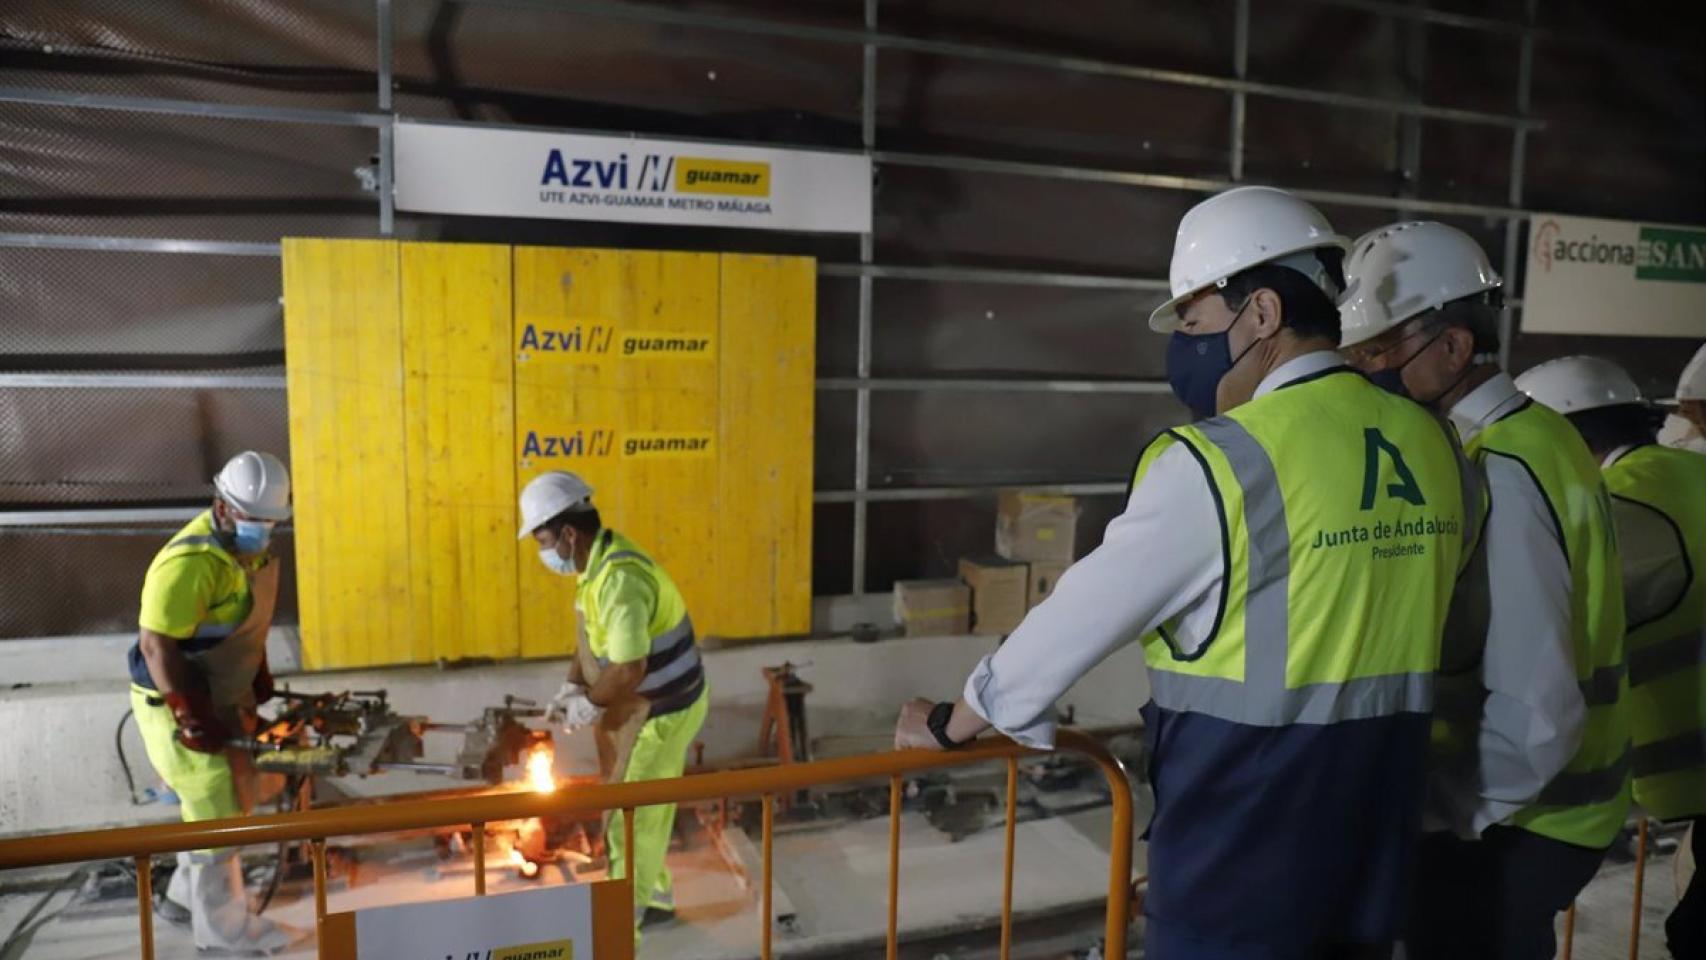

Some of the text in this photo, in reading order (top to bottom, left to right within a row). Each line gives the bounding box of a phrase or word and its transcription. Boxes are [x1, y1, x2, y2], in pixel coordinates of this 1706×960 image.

[541, 148, 761, 190] Azvi guamar
[540, 191, 772, 213] UTE AZVI-GUAMAR METRO MÁLAGA
[1553, 234, 1635, 266] acciona
[520, 323, 709, 355] Azvi guamar
[522, 430, 710, 458] Azvi guamar
[1312, 526, 1369, 549] Junta
[1373, 520, 1391, 540] de
[1372, 542, 1425, 560] Presidente
